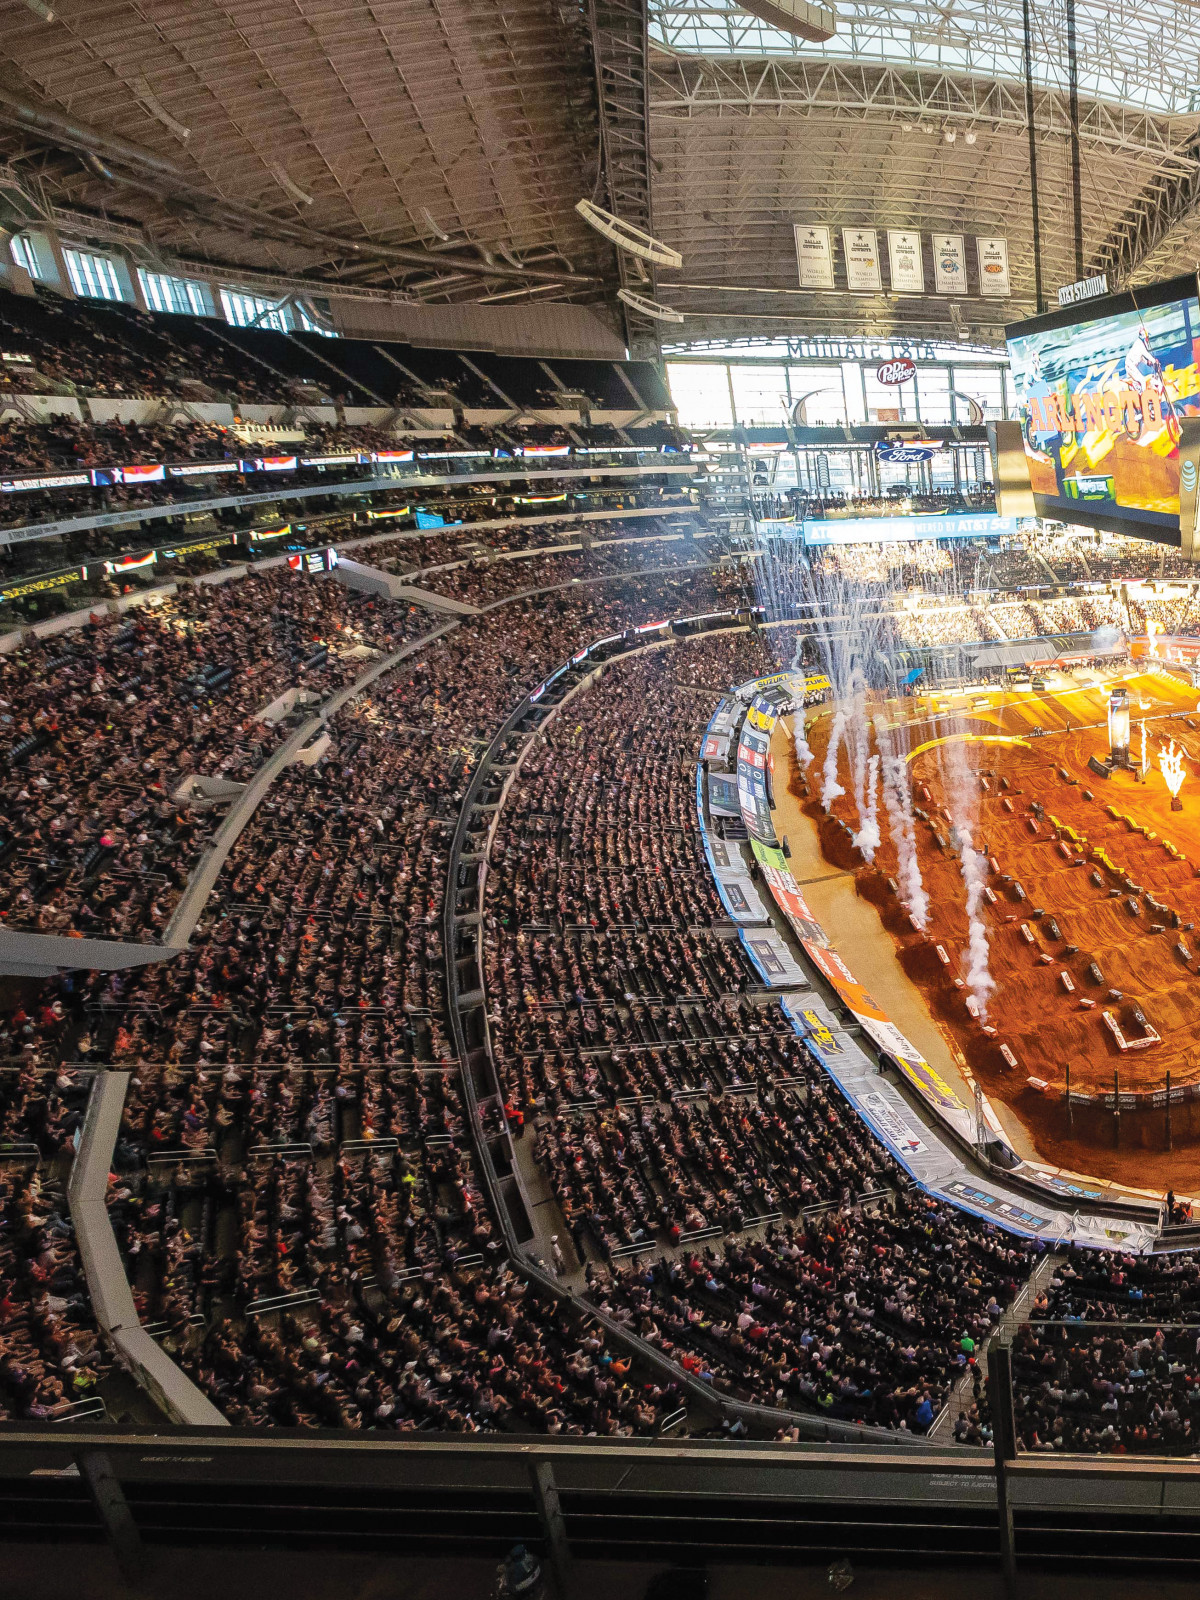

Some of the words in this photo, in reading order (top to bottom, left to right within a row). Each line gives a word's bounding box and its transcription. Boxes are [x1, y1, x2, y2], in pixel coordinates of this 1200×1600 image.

[1058, 286, 1075, 305] AT&T
[1075, 274, 1108, 302] STADIUM
[881, 365, 915, 383] Pepper
[892, 362, 906, 372] Dr
[1029, 390, 1163, 433] ARLINGTO
[888, 449, 924, 462] Ford
[958, 519, 988, 532] AT&T
[990, 517, 1011, 530] 5G
[757, 673, 787, 688] SUZUKI
[948, 1186, 990, 1208] GoPro
[995, 1207, 1038, 1229] GoPro
